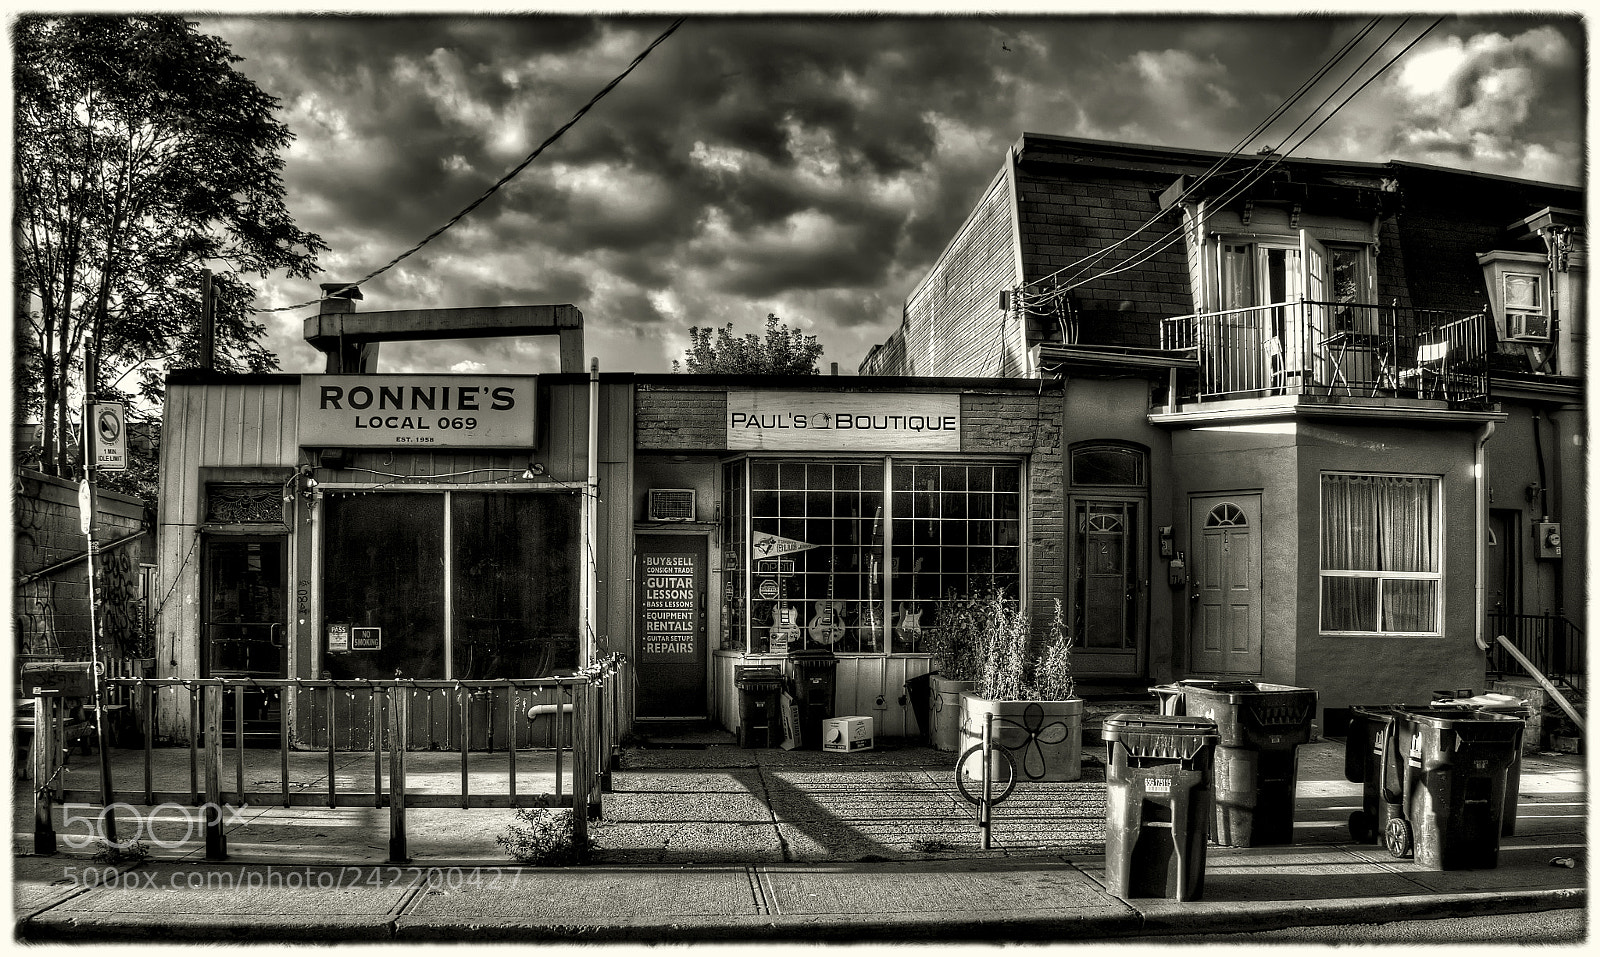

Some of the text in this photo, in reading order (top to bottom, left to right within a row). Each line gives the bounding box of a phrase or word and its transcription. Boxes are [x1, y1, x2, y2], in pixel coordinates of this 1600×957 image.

[320, 386, 515, 411] RONNIE'S
[355, 416, 478, 429] LOCAL 069
[1101, 541, 1108, 554] 2
[646, 557, 694, 566] BUY&SELL
[647, 577, 693, 589] GUITAR
[646, 589, 694, 600] LESSONS
[646, 612, 694, 620] EQUIPMENT
[646, 621, 693, 631] RENTALS
[362, 630, 371, 638] NO
[354, 638, 379, 646] SMOKING
[646, 643, 694, 653] REPAIRS
